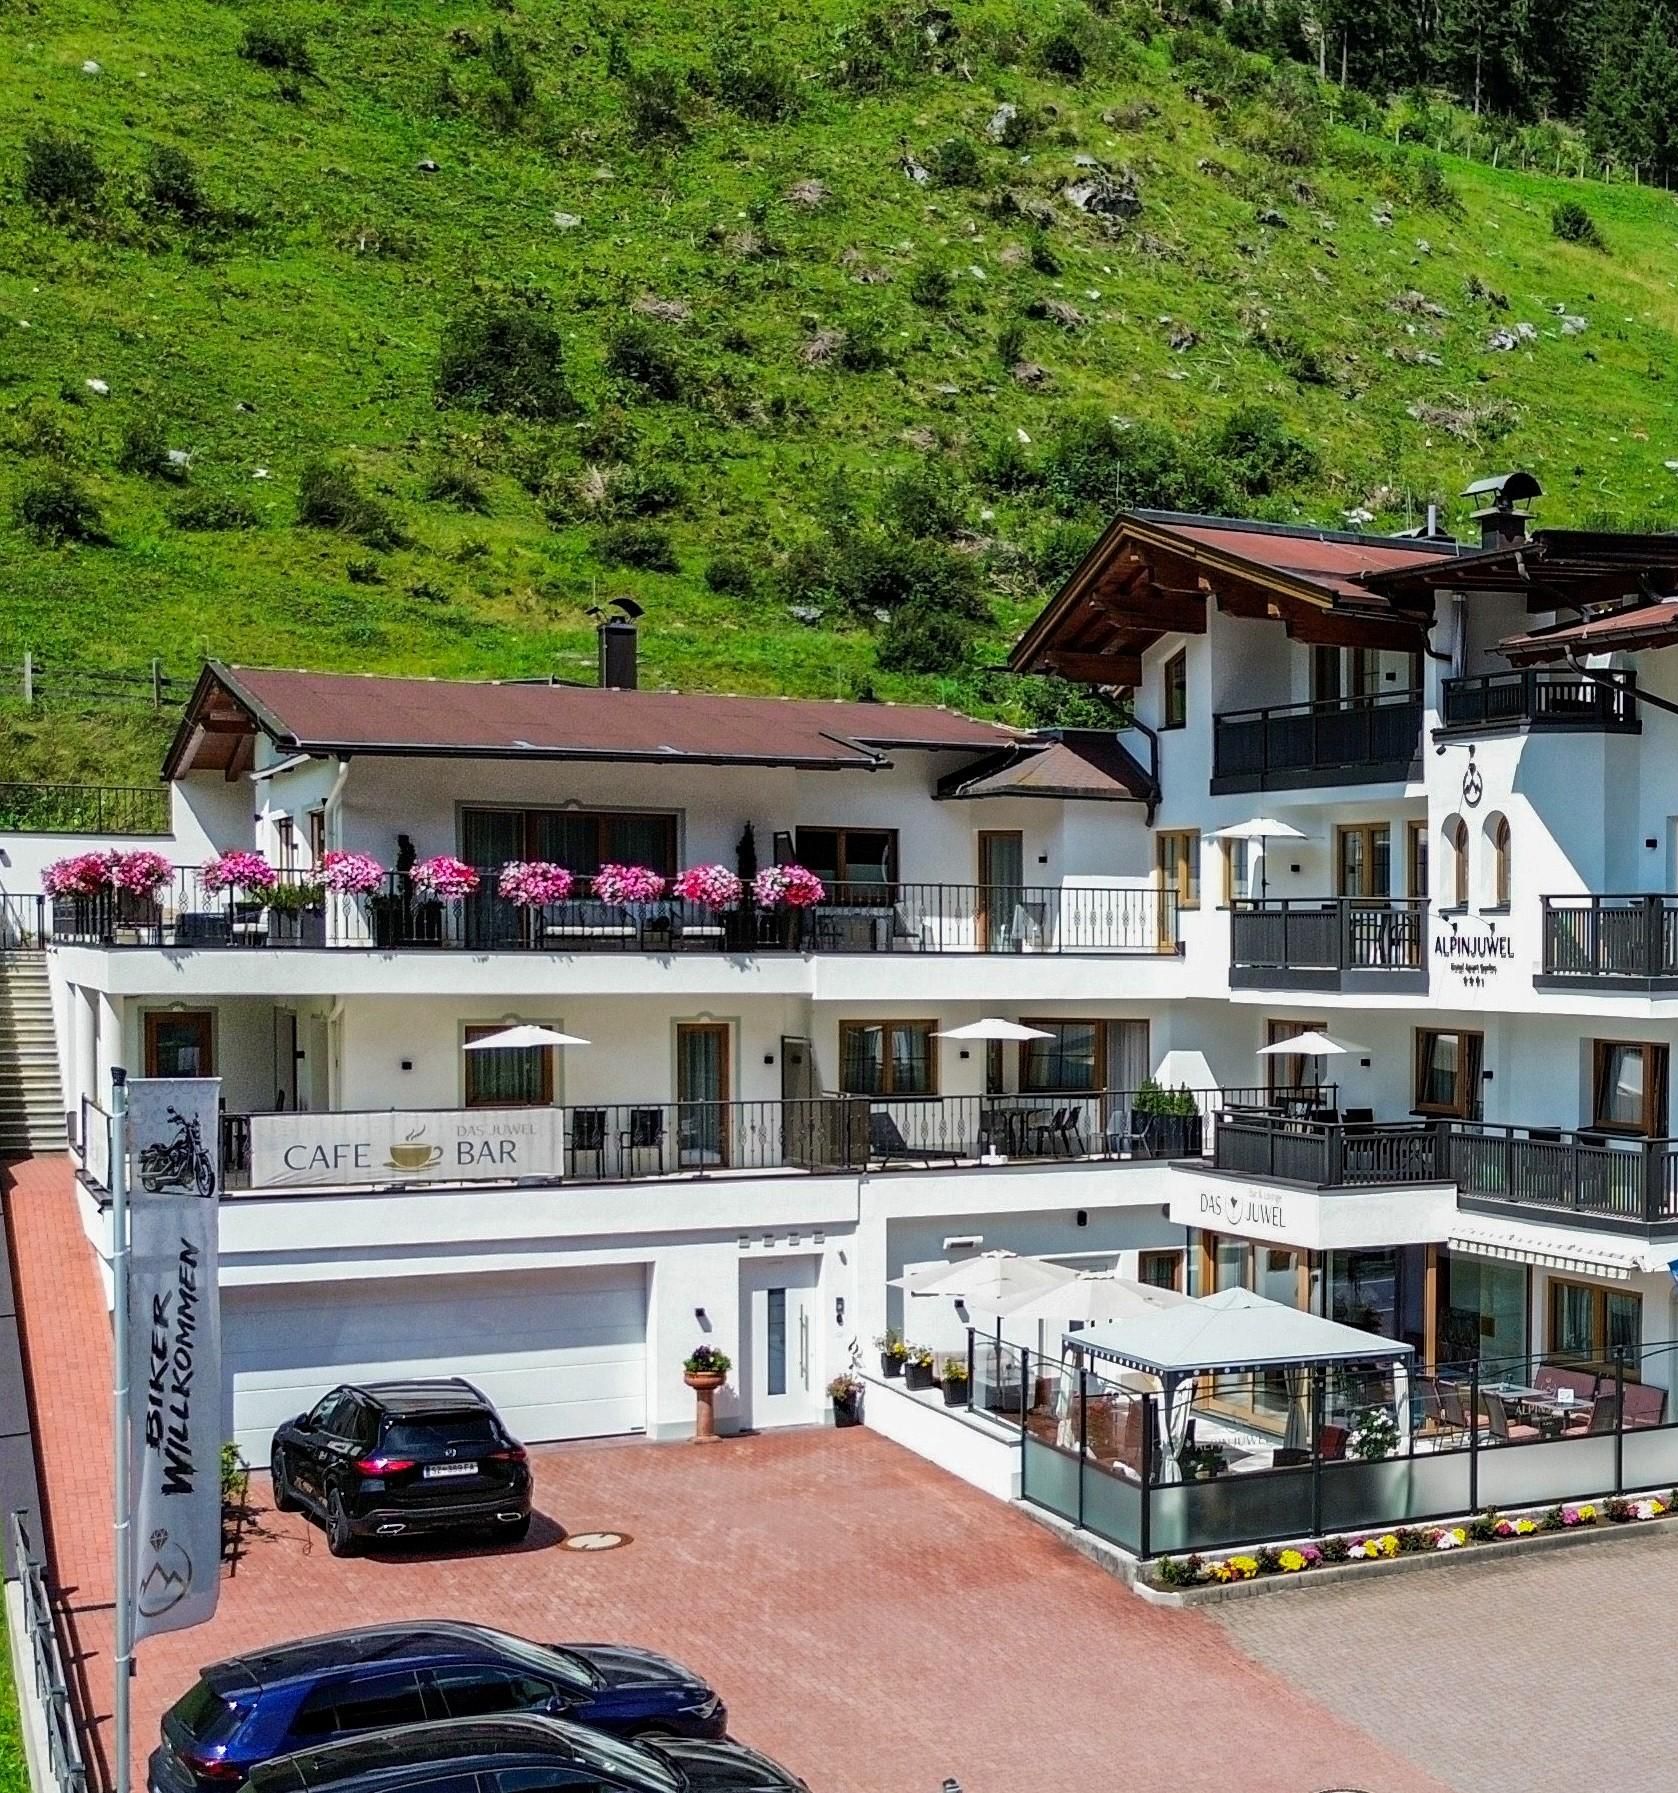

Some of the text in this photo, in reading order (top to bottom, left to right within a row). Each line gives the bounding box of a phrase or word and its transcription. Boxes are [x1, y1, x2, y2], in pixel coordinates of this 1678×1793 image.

[1434, 935, 1515, 958] ALPINJUWEL
[456, 1122, 537, 1138] DAS JUWEL
[283, 1143, 372, 1171] CAFE
[457, 1139, 518, 1166] BAR
[1200, 1192, 1287, 1228] DAS JUWEL
[146, 1289, 173, 1457] BIKER
[161, 1236, 200, 1497] WILLKOMMEN
